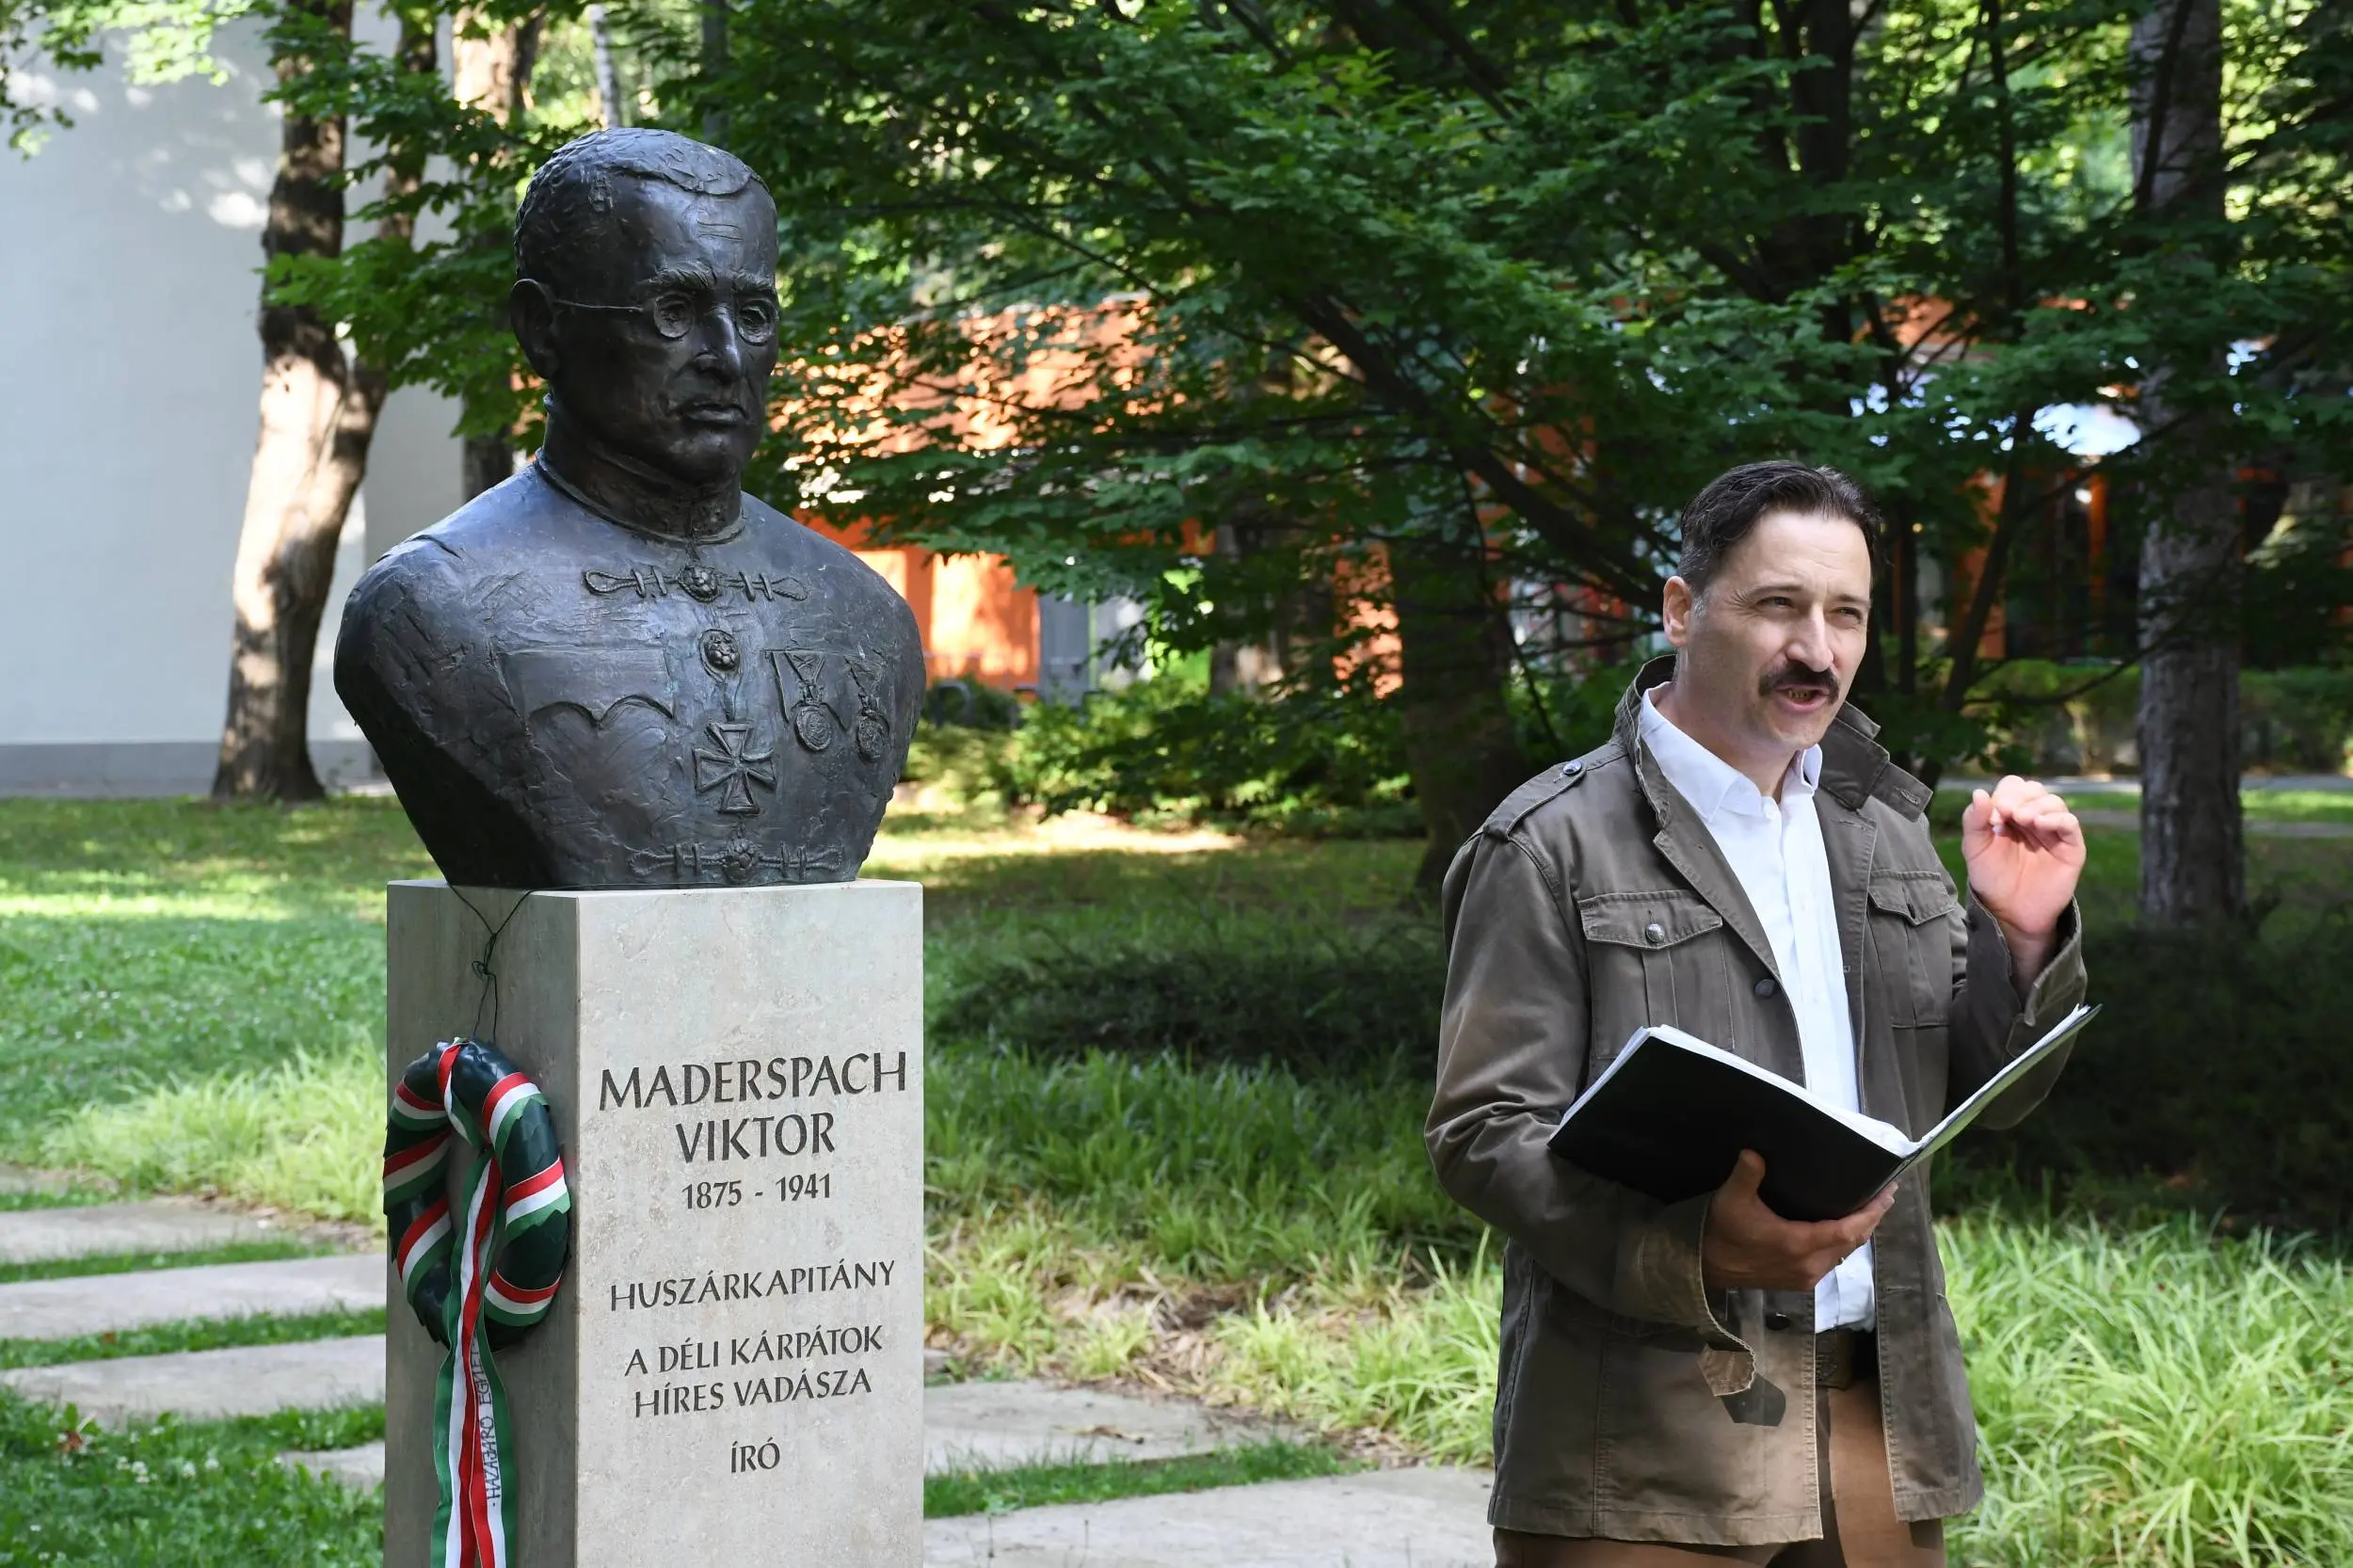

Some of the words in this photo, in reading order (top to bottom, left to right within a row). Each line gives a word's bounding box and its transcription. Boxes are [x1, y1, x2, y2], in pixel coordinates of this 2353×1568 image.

[599, 1051, 906, 1111] MADERSPACH
[675, 1112, 836, 1163] VIKTOR
[681, 1179, 743, 1209] 1875
[776, 1173, 831, 1203] 1941
[610, 1257, 895, 1312] HUSZÁRKAPITÁNY
[624, 1349, 649, 1377] A
[658, 1337, 720, 1373] DÉLI
[730, 1324, 884, 1366] KÁRPÁTOK
[635, 1380, 725, 1418] HÍRES
[733, 1367, 872, 1407] VADÁSZA
[730, 1436, 781, 1474] ÍRÓ
